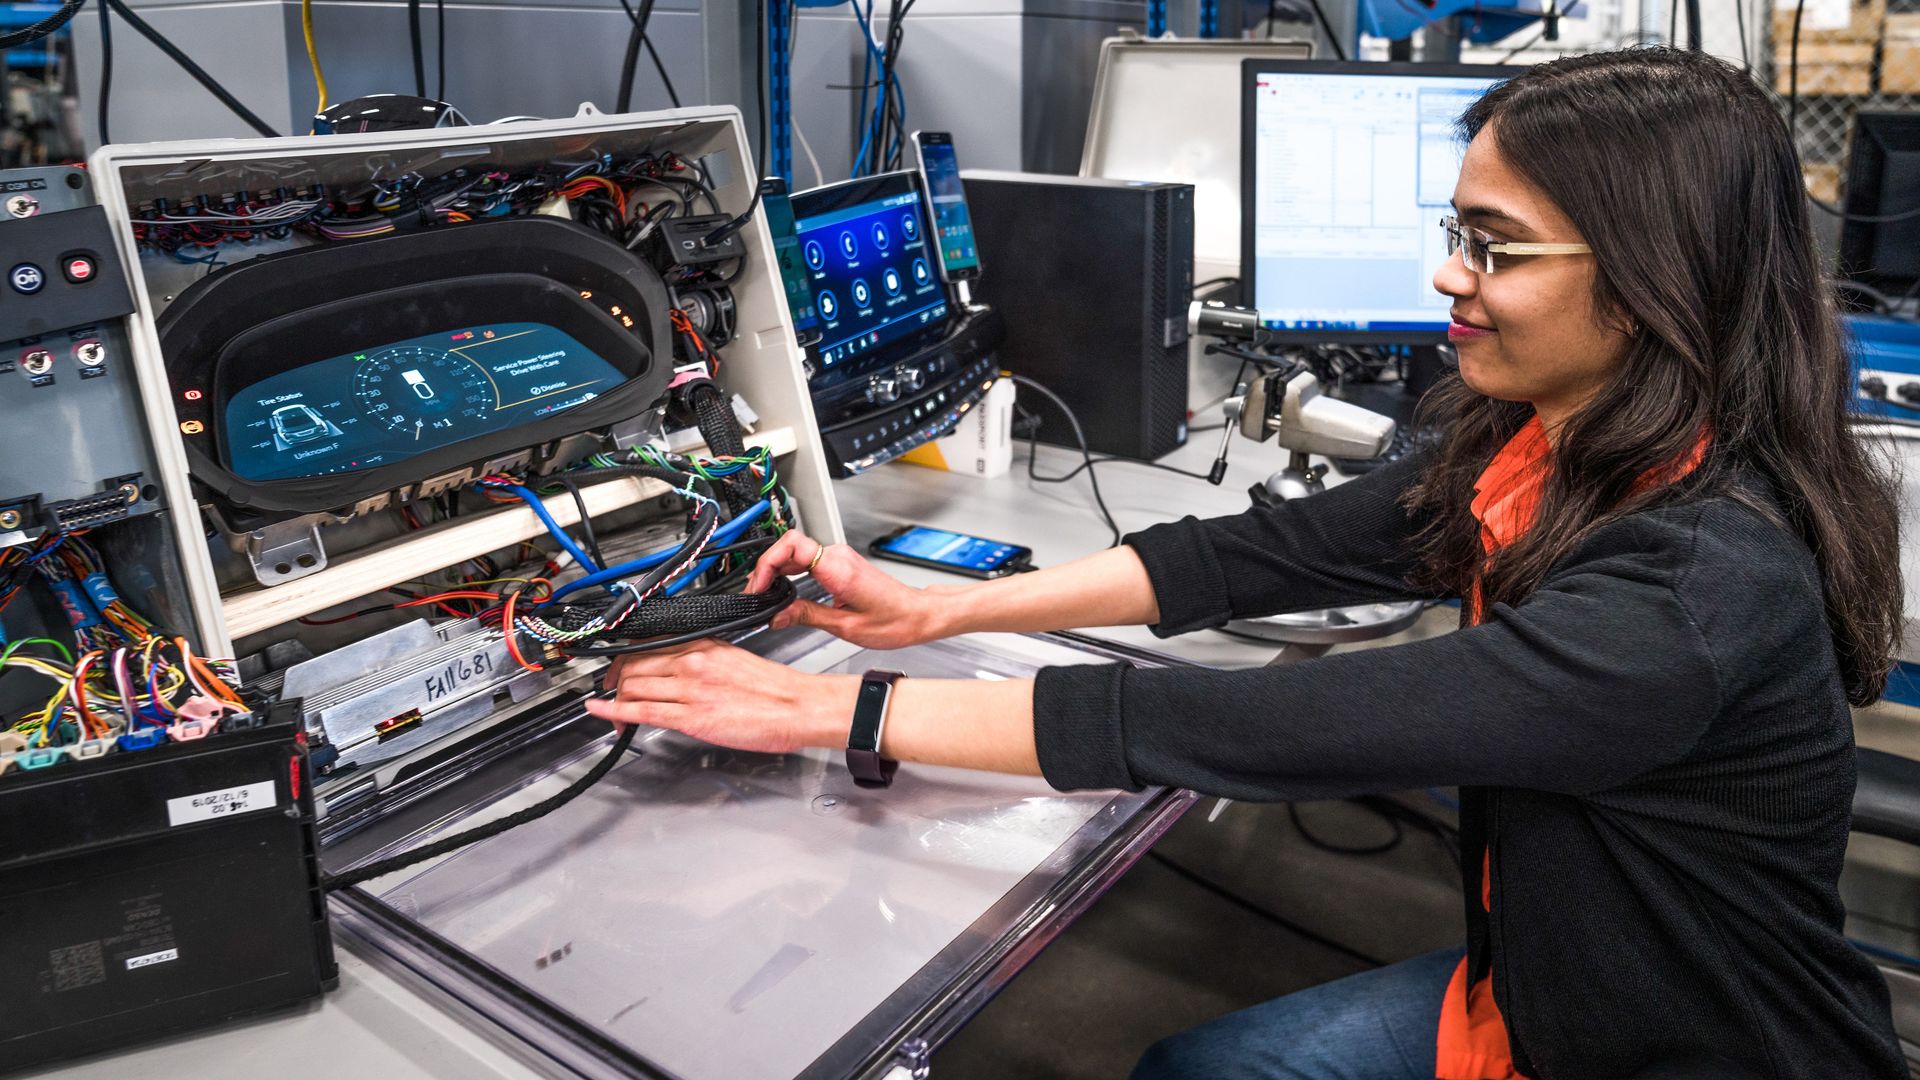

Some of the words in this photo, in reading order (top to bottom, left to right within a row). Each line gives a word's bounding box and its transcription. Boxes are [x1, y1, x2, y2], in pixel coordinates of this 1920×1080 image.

[492, 359, 518, 373] Service
[517, 356, 539, 367] Power
[537, 350, 566, 362] Steering
[509, 367, 530, 377] Drive
[528, 362, 545, 372] With
[543, 359, 560, 368] Care
[367, 388, 381, 398] 30
[412, 382, 434, 399] 0
[540, 380, 568, 393] Dismiss
[257, 398, 277, 407] Tire
[276, 392, 303, 403] Status
[375, 402, 389, 411] 20
[392, 414, 405, 423] 10
[294, 445, 333, 460] Unknown
[192, 789, 249, 808] 6/12/2019
